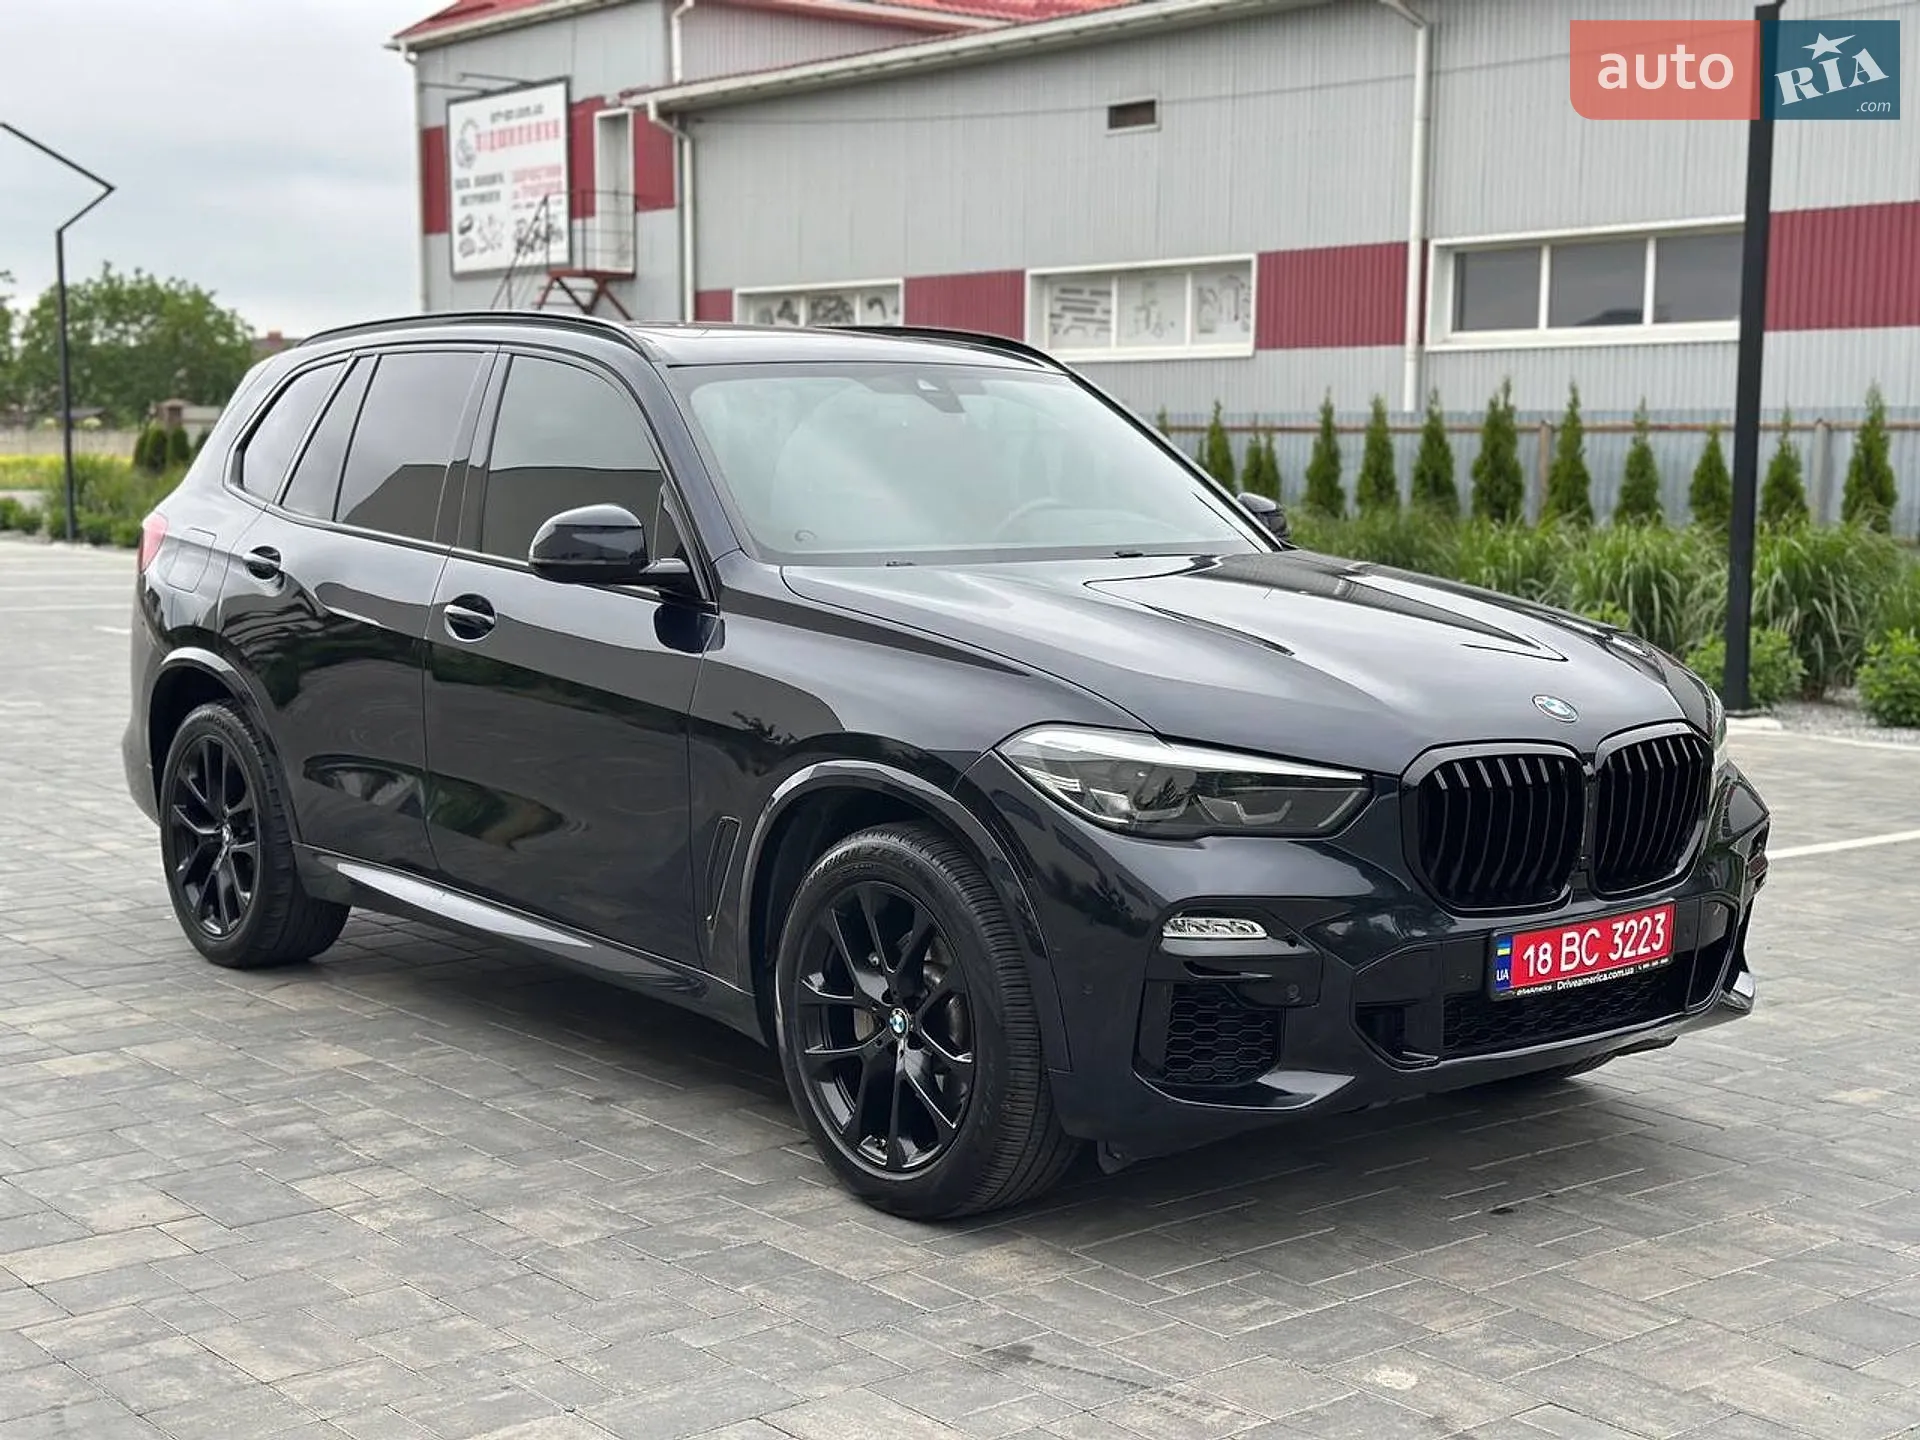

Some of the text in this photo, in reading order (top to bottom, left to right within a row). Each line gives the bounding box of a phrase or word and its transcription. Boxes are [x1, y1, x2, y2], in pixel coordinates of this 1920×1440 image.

[1523, 912, 1666, 978] 18 BC 3223
[1496, 968, 1509, 981] UA
[1557, 967, 1634, 990] Driveamerica.com.ua
